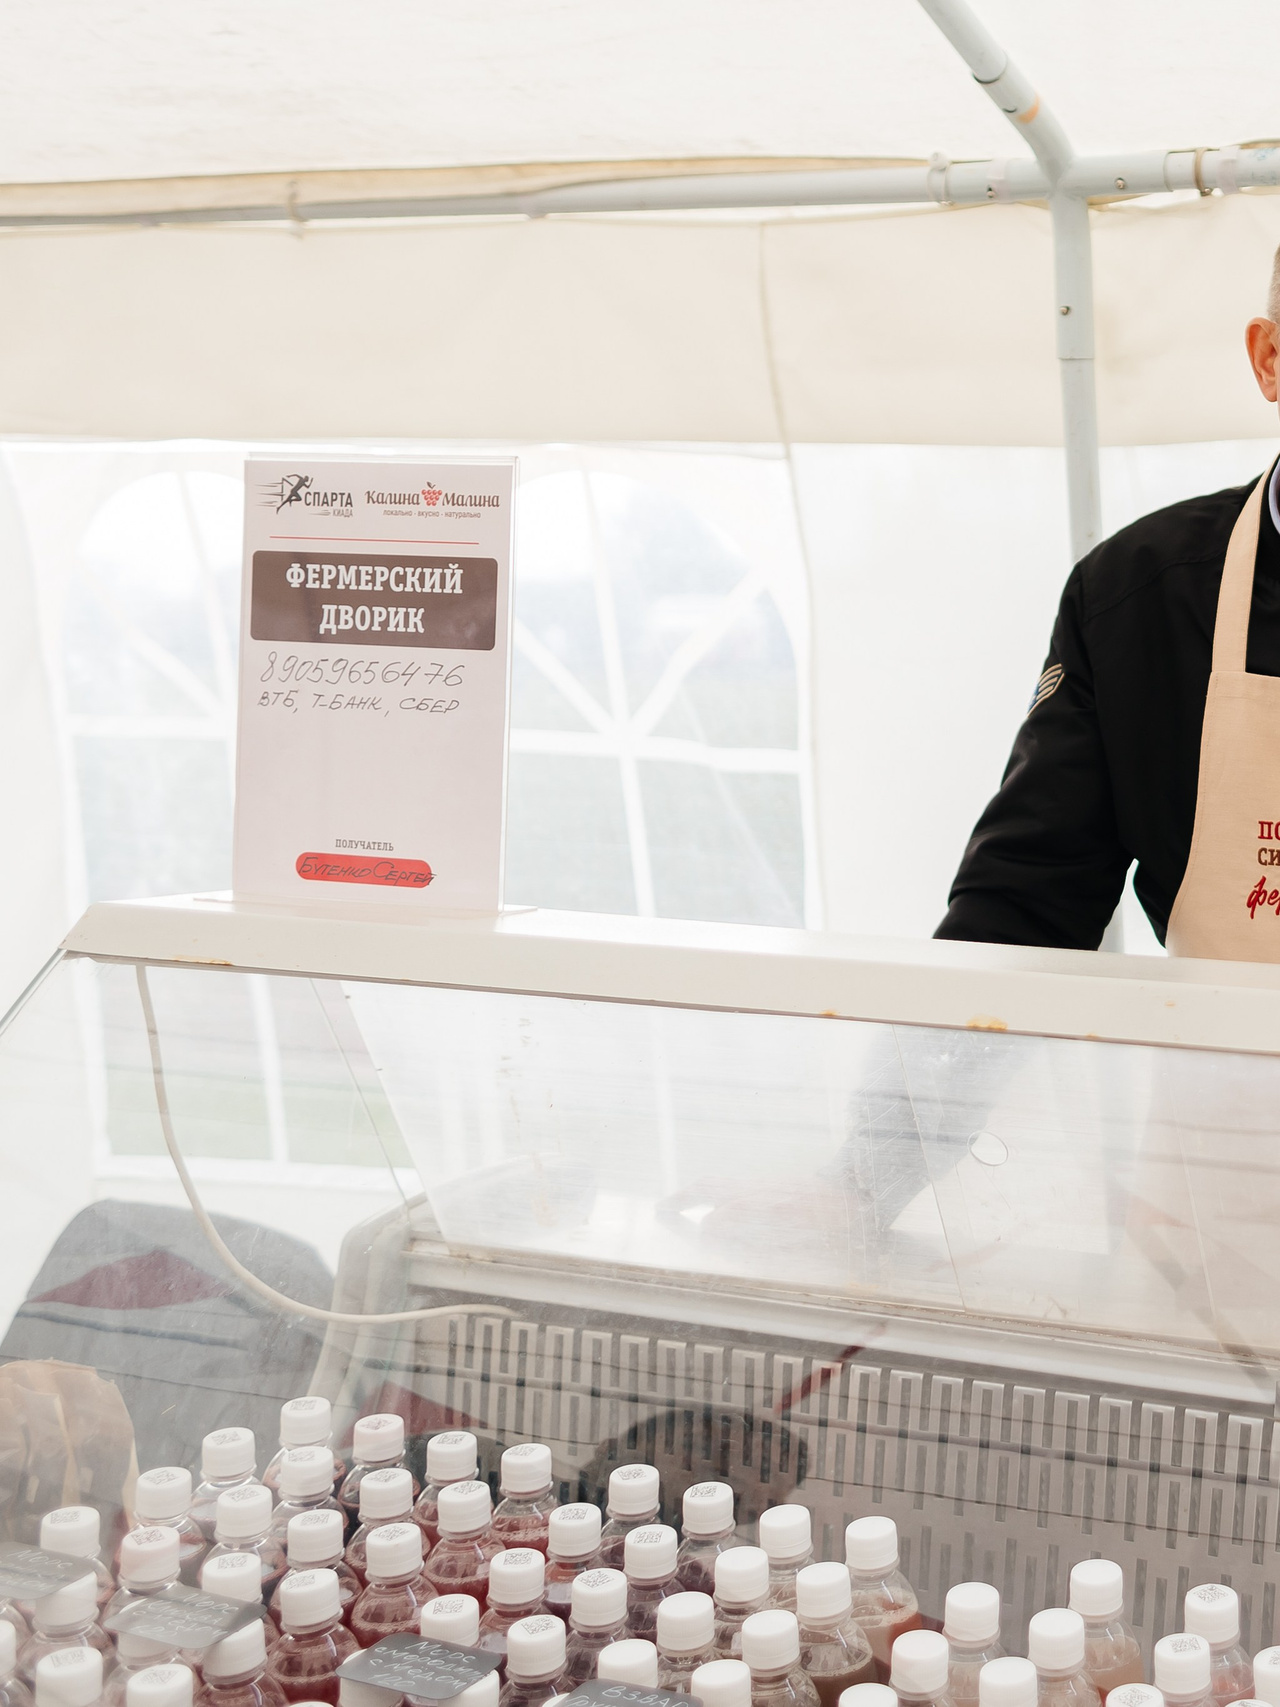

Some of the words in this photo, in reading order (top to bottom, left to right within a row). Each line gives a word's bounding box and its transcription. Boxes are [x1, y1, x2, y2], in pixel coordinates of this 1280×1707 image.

[304, 492, 353, 508] СПАРТА
[365, 490, 421, 506] Калина
[332, 509, 353, 518] КИАДА
[382, 509, 413, 517] локально
[417, 510, 440, 519] вкусно
[444, 511, 482, 520] натурально
[286, 563, 463, 594] ФЕРМЕРСКИЙ
[319, 604, 424, 635] ДВОРИК
[260, 651, 465, 686] 89059656476
[399, 697, 460, 714] СБЕР
[335, 839, 394, 852] ПОЛУЧАТЕЛЬ
